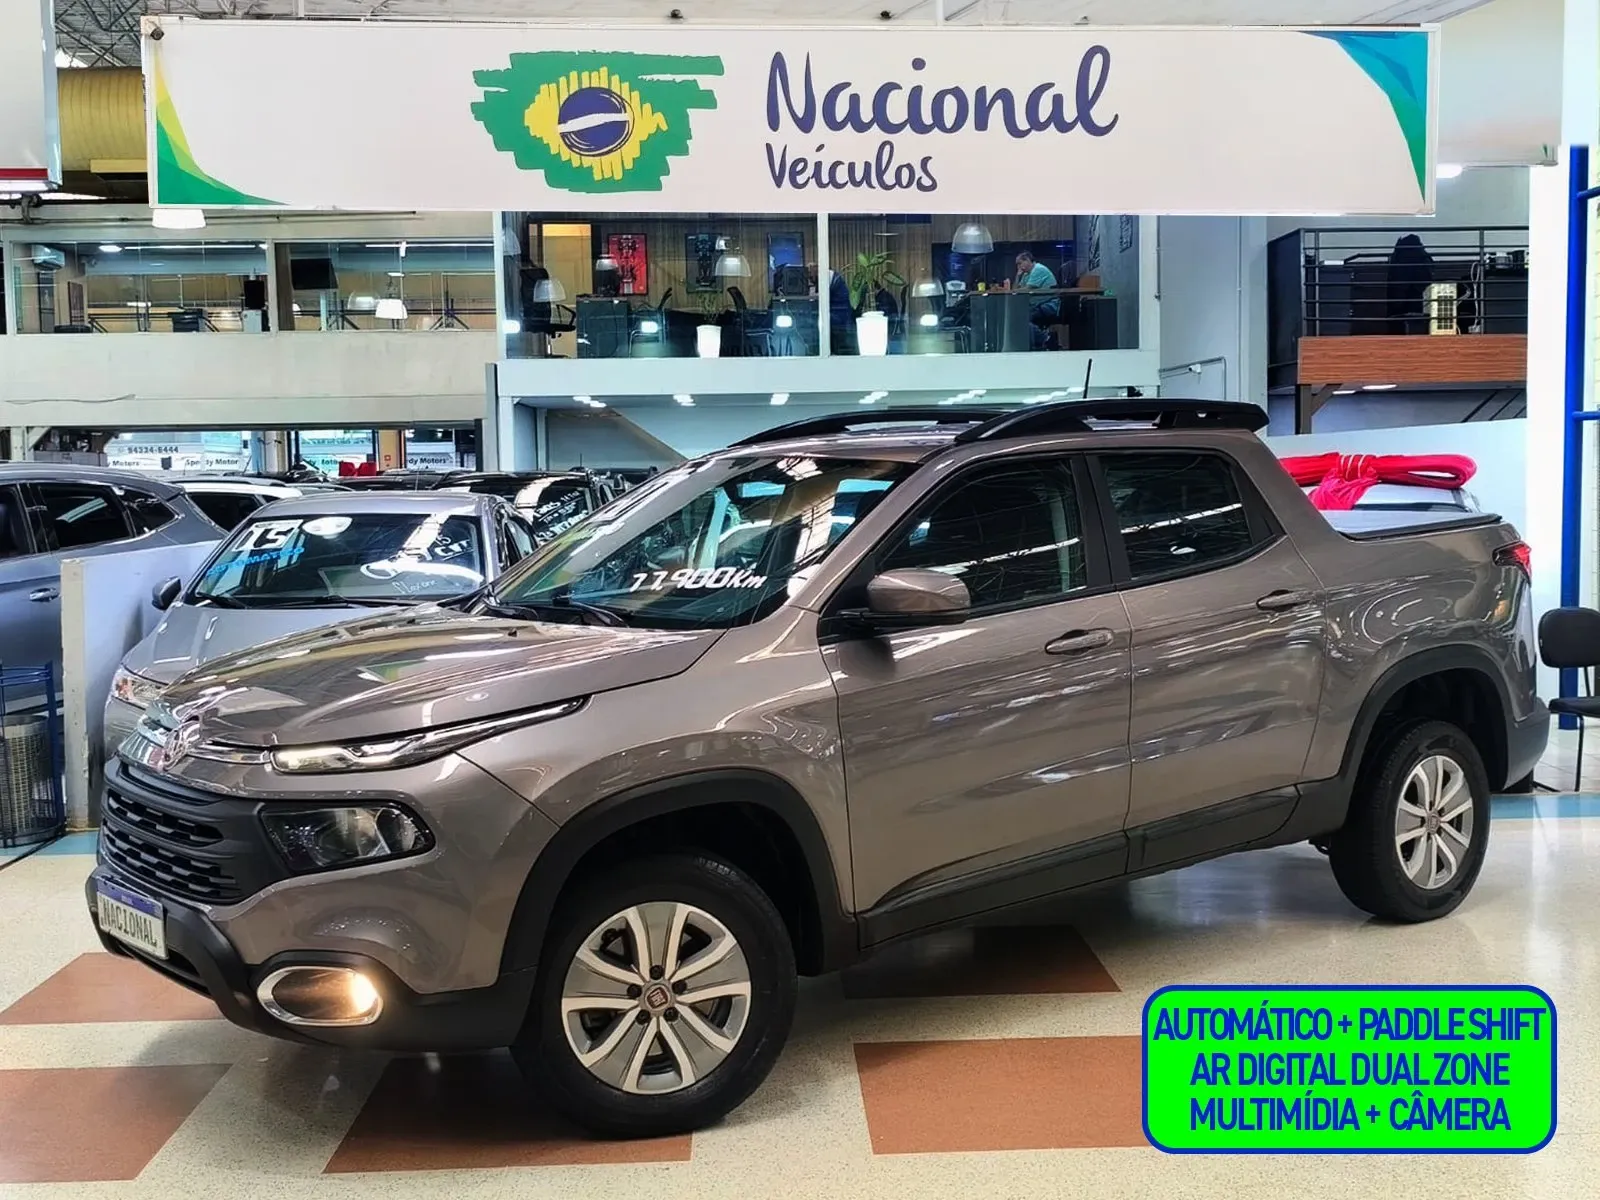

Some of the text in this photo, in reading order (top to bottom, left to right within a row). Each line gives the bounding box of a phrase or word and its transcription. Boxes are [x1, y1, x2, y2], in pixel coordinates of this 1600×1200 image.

[766, 45, 1119, 138] Nacional
[765, 140, 938, 192] Veículos
[102, 898, 158, 948] NACIONAL
